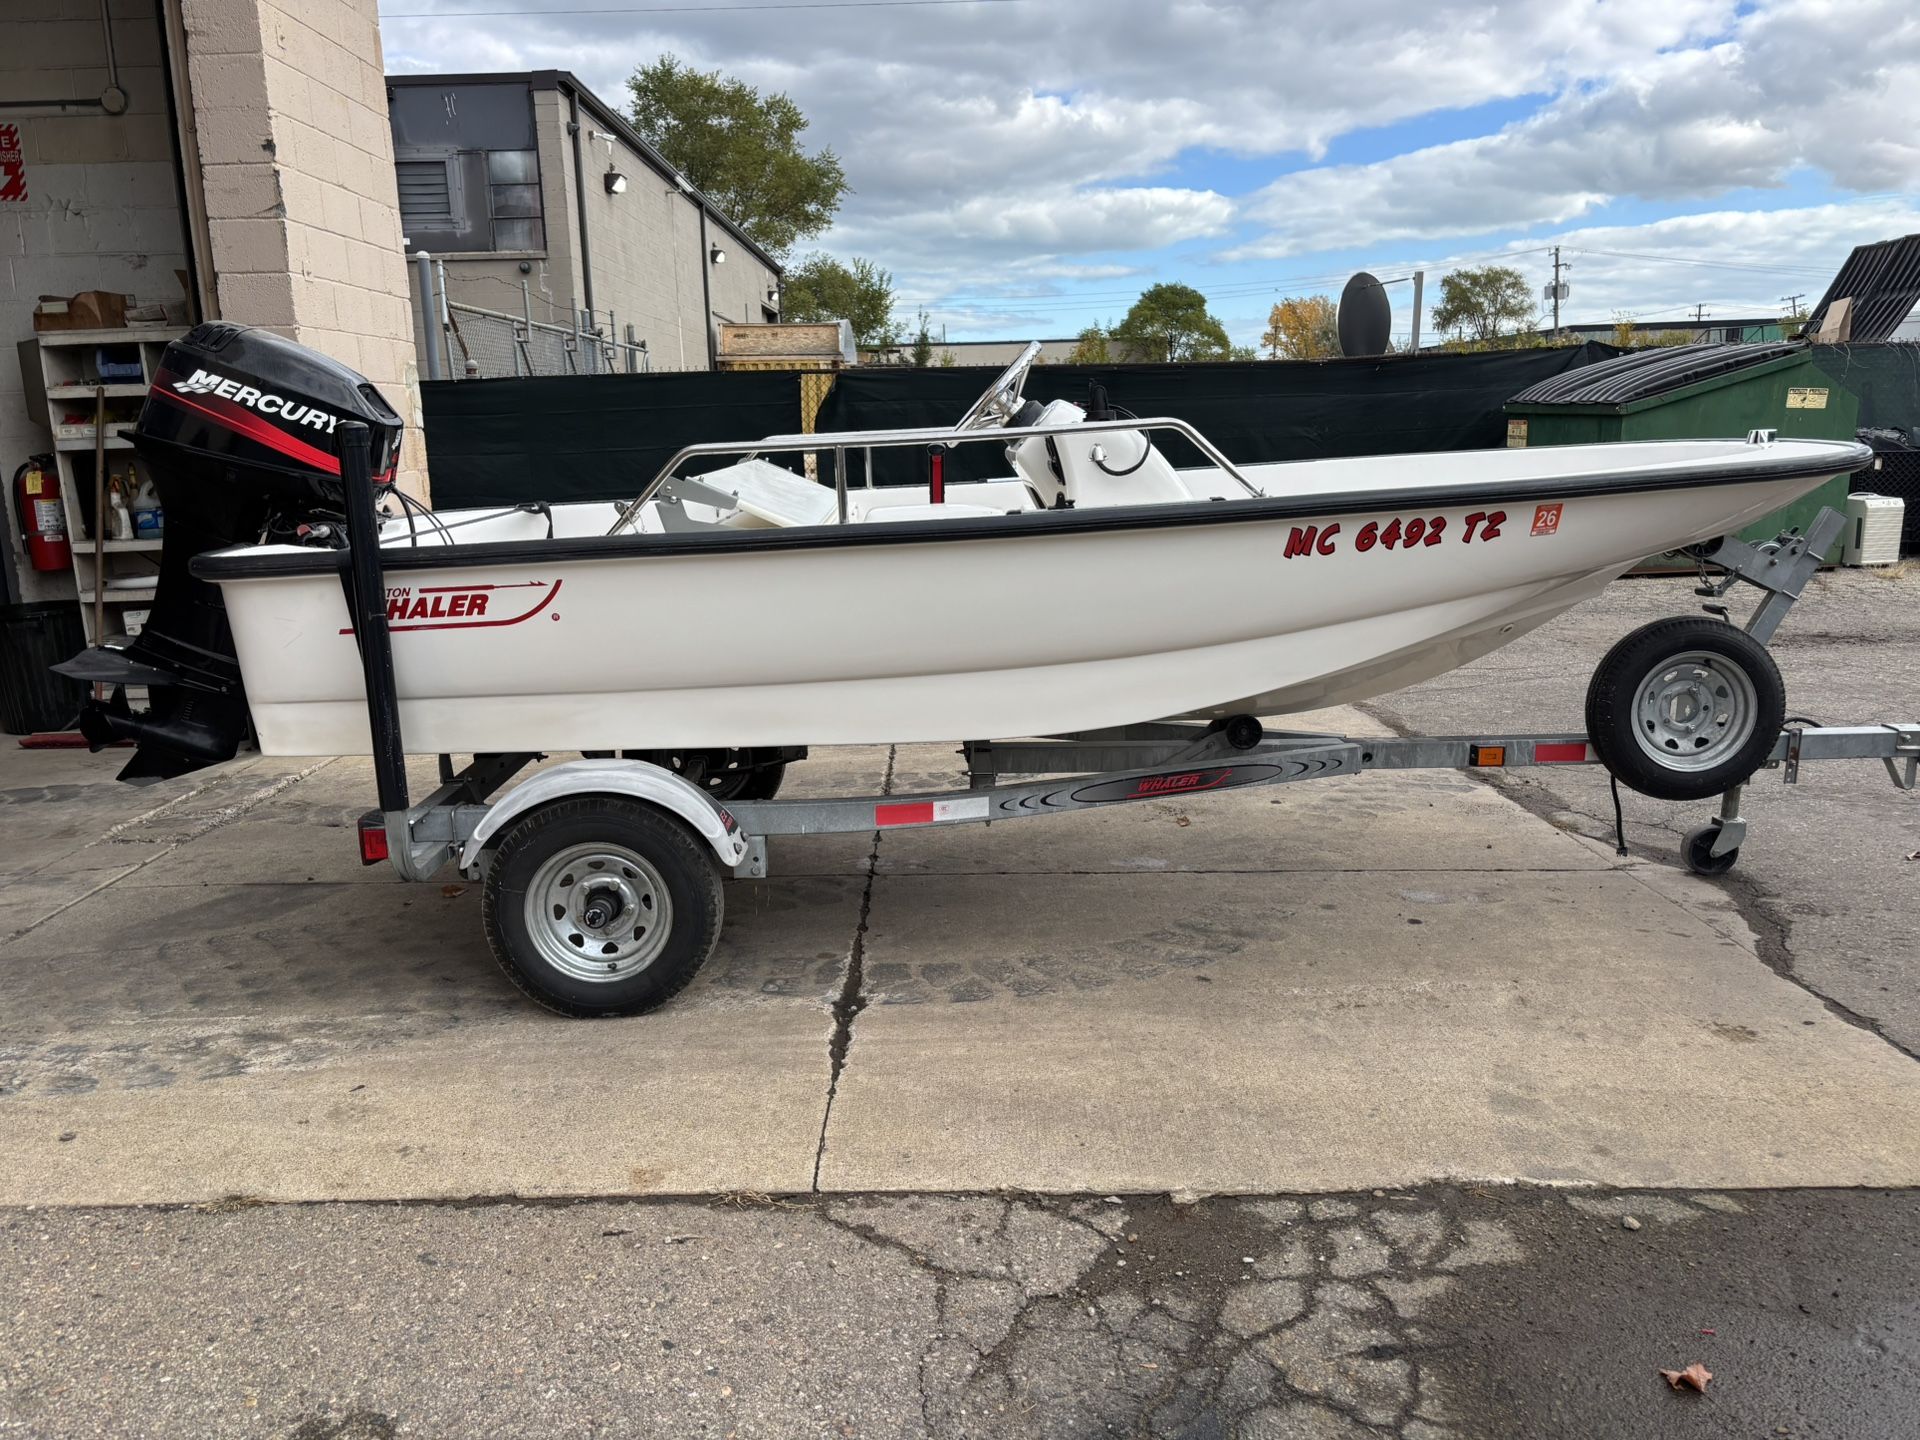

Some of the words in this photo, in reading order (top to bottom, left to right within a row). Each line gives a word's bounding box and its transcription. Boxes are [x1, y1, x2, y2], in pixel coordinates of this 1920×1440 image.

[182, 369, 347, 434] MERCURY
[1536, 510, 1557, 527] 26
[1283, 523, 1341, 559] MC
[1355, 516, 1447, 552] 6492
[387, 587, 411, 598] TON
[386, 594, 489, 620] HALER
